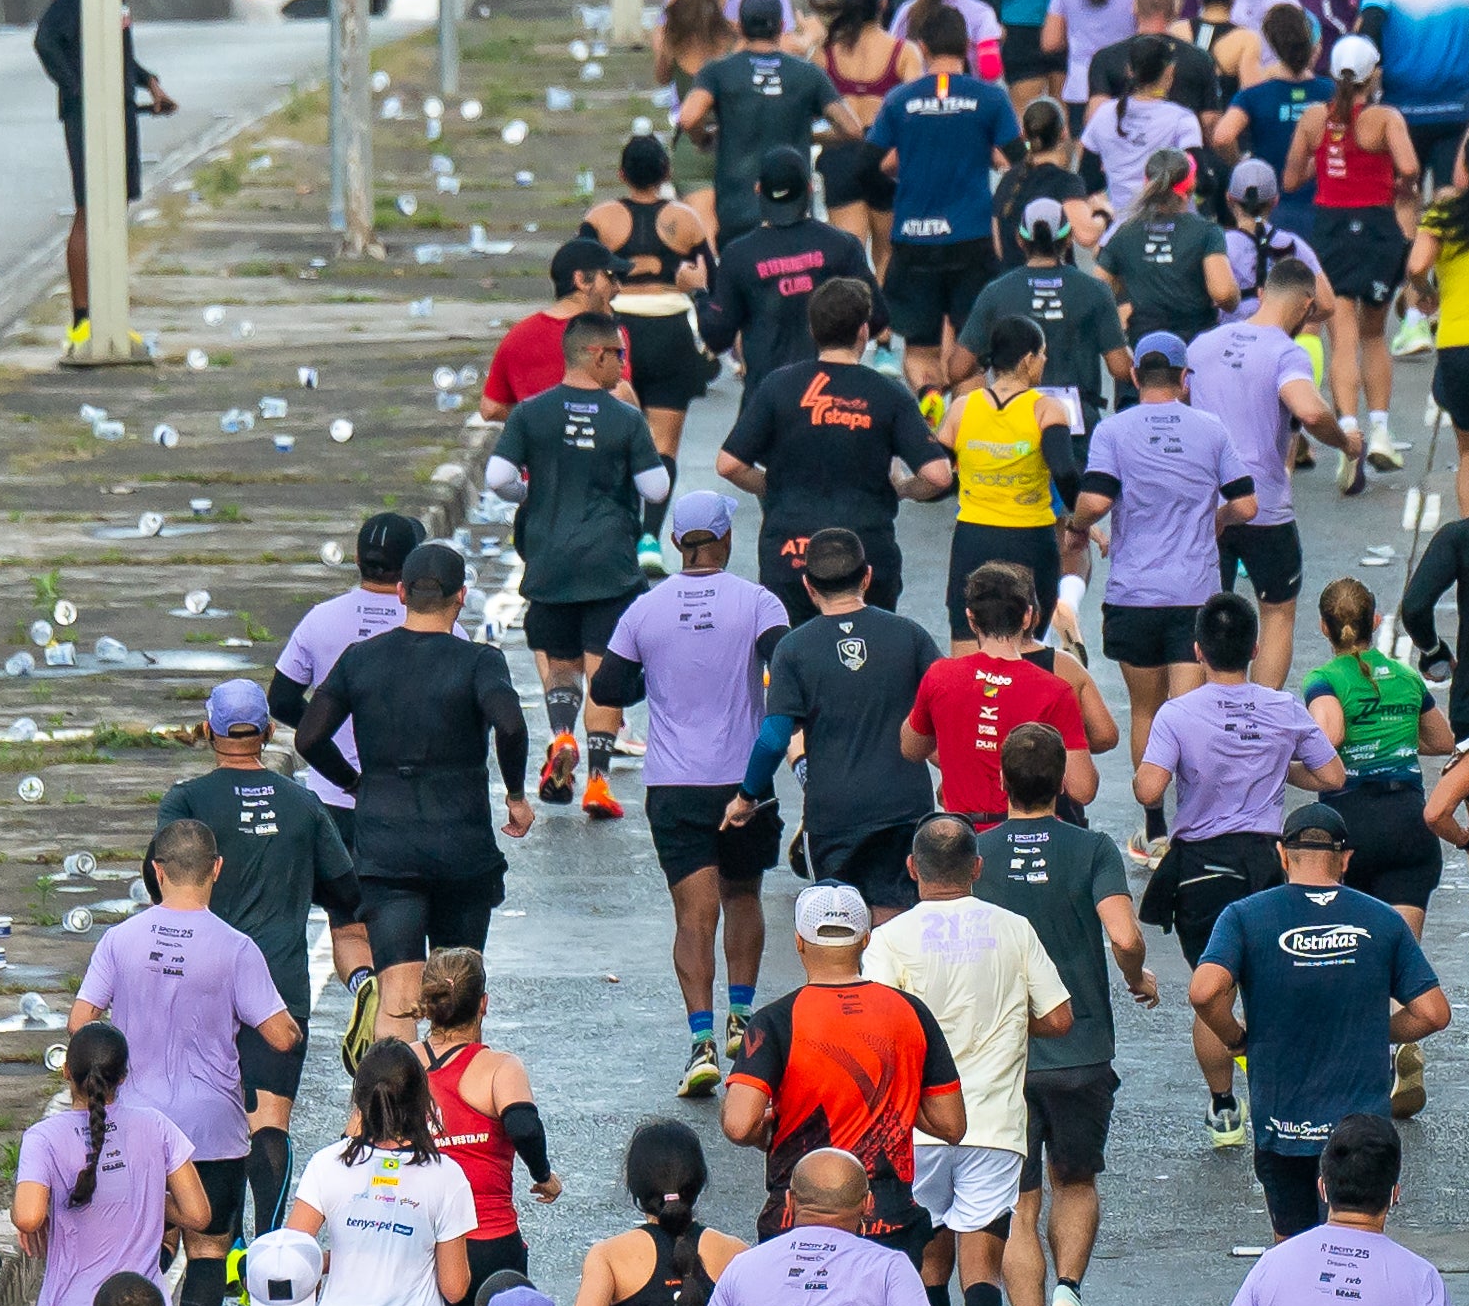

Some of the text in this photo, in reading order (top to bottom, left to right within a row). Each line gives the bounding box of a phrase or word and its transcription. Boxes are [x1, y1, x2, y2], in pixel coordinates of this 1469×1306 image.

[901, 218, 952, 236] ATLETA
[824, 409, 873, 430] steps
[704, 589, 716, 598] 25
[1035, 831, 1051, 843] 25
[921, 911, 961, 941] 21
[181, 929, 195, 938] 25
[1292, 933, 1358, 951] Rstintas
[104, 1123, 118, 1133] 25
[822, 1242, 837, 1253] 25
[1355, 1248, 1371, 1260] 25
[1344, 1276, 1363, 1286] rvb
